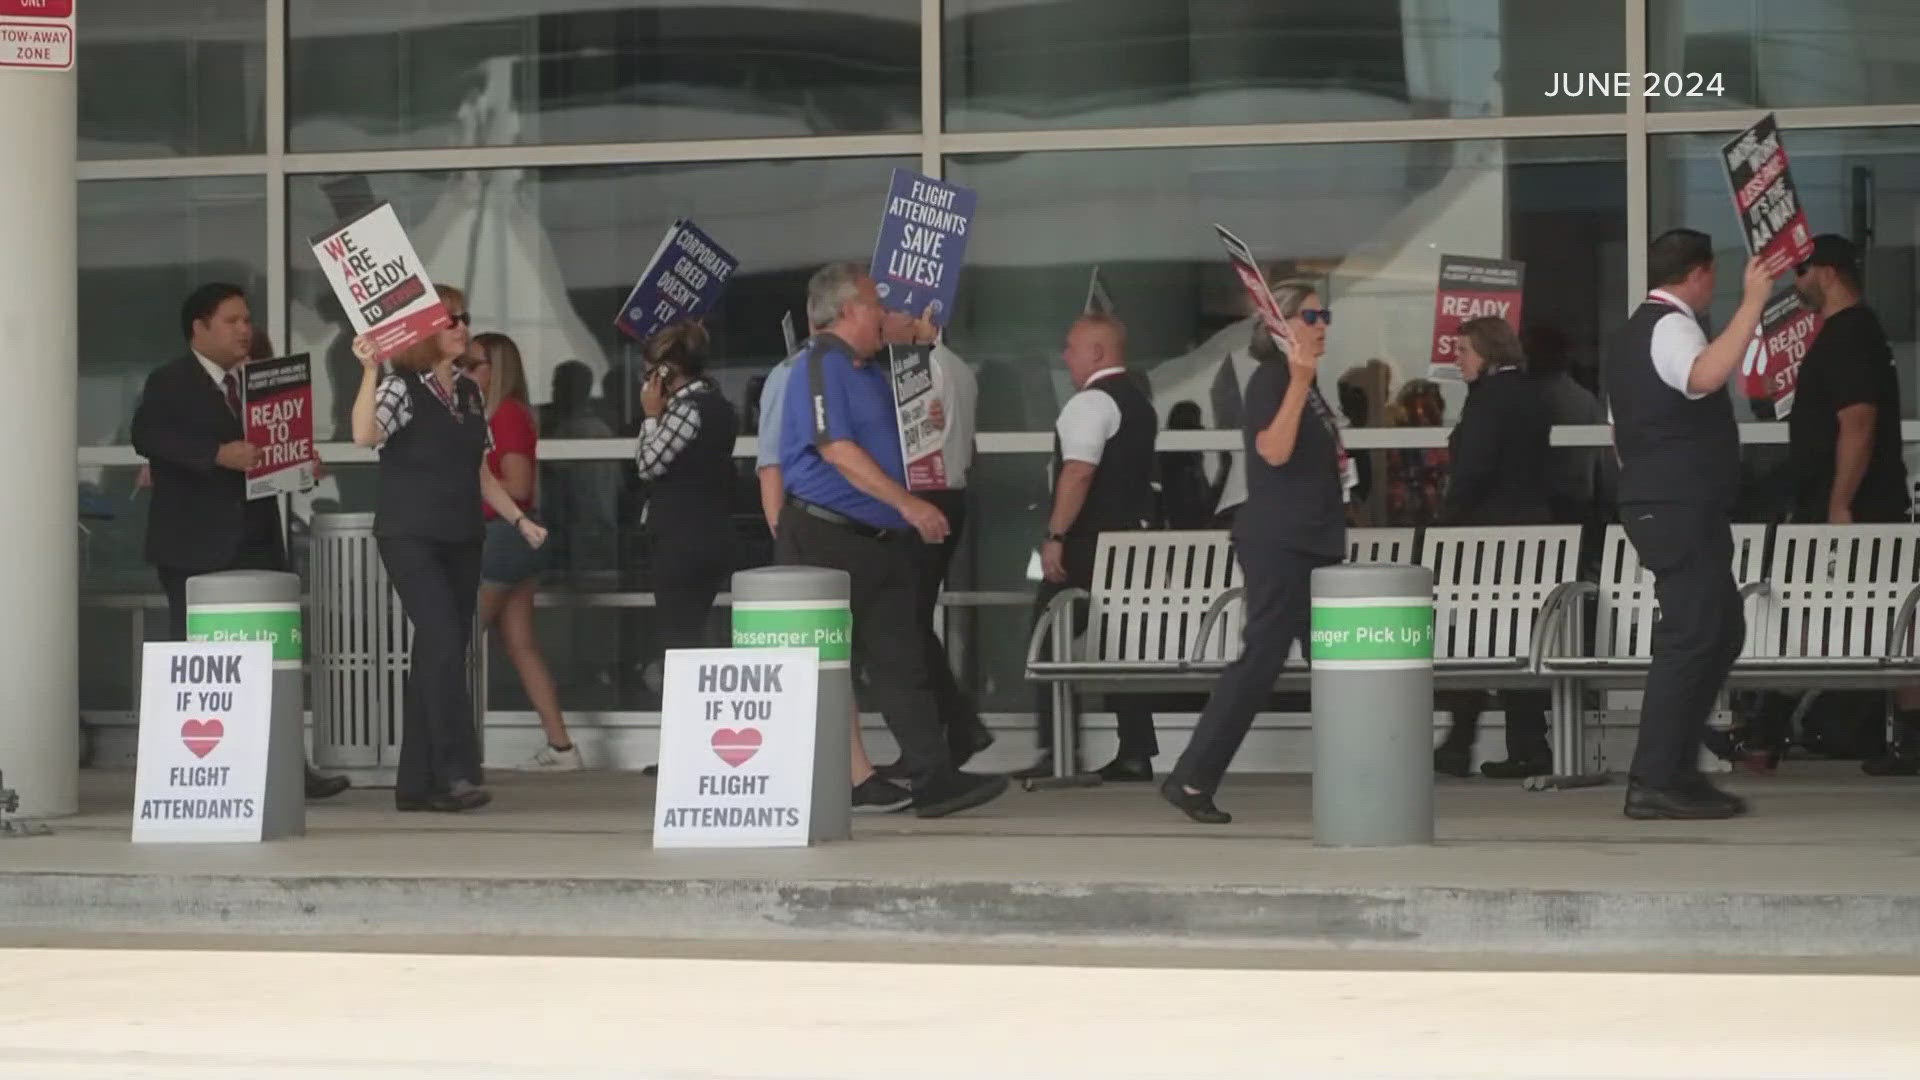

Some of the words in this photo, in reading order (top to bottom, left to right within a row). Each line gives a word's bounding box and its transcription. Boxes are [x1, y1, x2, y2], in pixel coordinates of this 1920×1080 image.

[1, 30, 67, 43] TOW-AWAY
[17, 47, 51, 59] ZONE
[911, 181, 956, 210] FLIGHT
[889, 197, 967, 236] ATTENDANTS
[324, 231, 357, 262] WE
[901, 224, 945, 259] SAVE
[341, 248, 377, 283] ARE
[676, 229, 731, 282] CORPORATE
[350, 255, 409, 305] READY
[674, 256, 707, 290] GREED
[889, 250, 944, 288] LIVES!
[657, 271, 700, 312] DOESN'T
[363, 307, 384, 324] TO
[654, 299, 677, 323] FLY
[1442, 295, 1510, 319] READY
[1768, 313, 1815, 356] READY
[1785, 341, 1806, 363] TO
[251, 398, 304, 426] READY
[266, 421, 289, 444] TO
[256, 438, 309, 467] TRIKE
[213, 630, 248, 642] Pick
[256, 630, 278, 643] Up
[814, 629, 843, 644] Pick
[1356, 627, 1395, 642] Pick
[1401, 627, 1421, 647] Up
[170, 655, 242, 684] HONK
[698, 664, 783, 692] HONK
[176, 692, 191, 712] IF
[198, 692, 233, 712] YOU
[705, 700, 723, 720] IF
[731, 700, 772, 720] YOU
[170, 767, 230, 786] FLIGHT
[699, 775, 769, 795] FLIGHT
[141, 799, 254, 819] ATTENDANTS
[663, 807, 800, 828] ATTENDANTS
